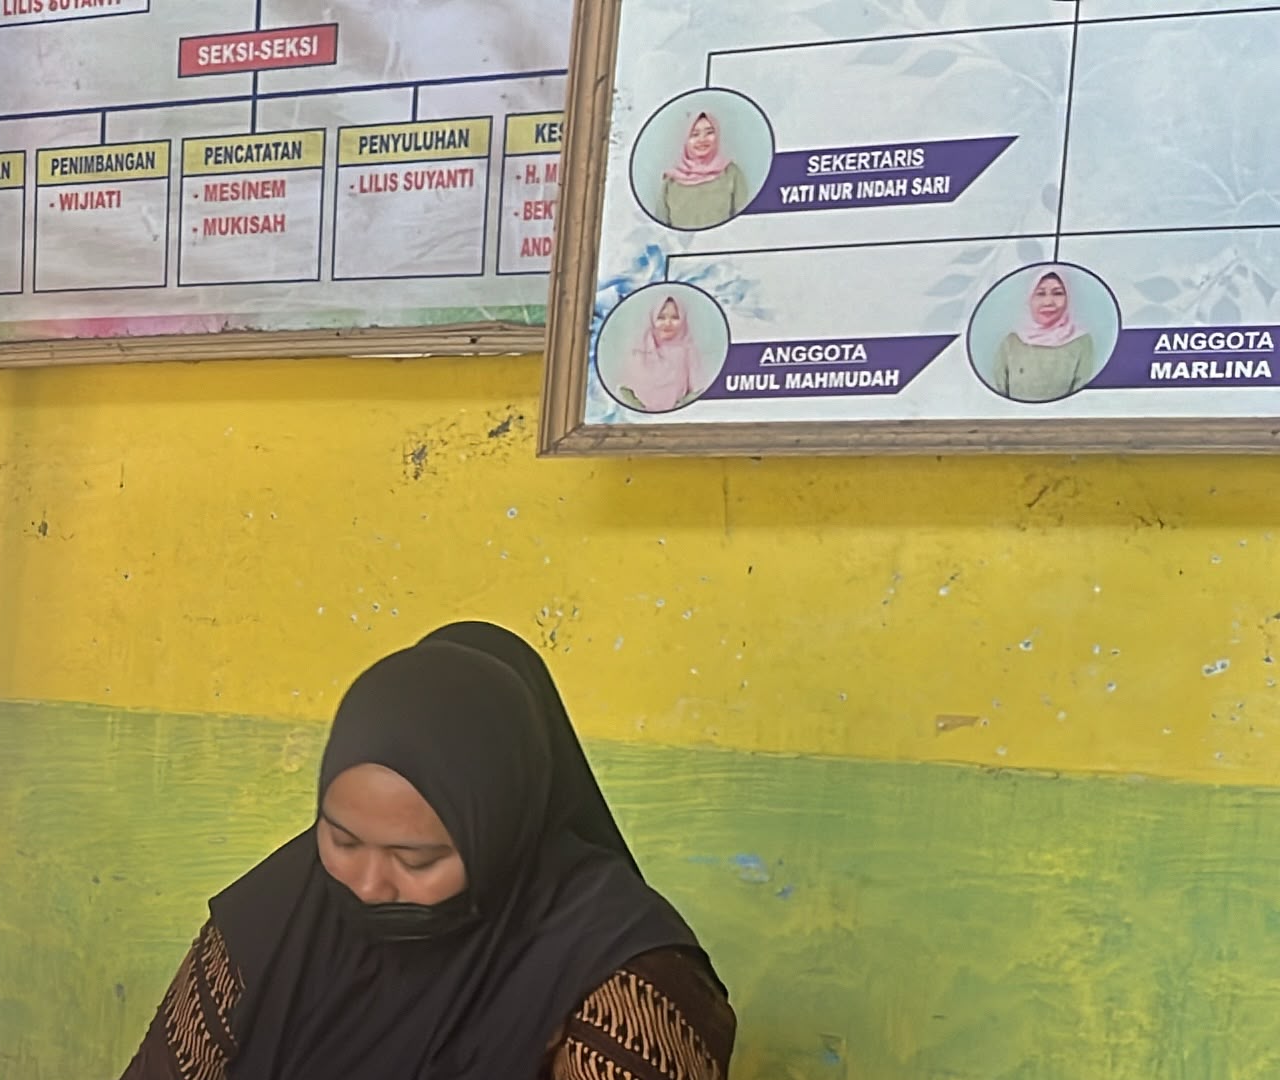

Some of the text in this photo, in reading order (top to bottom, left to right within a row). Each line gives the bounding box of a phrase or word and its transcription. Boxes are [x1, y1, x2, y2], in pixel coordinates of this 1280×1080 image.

[197, 34, 318, 66] SEKSI-SEKSI
[204, 140, 303, 165] PENCATATAN
[358, 128, 470, 155] PENYULUHAN
[51, 151, 156, 176] PENIMBANGAN
[807, 149, 925, 174] SEKERTARIS
[204, 179, 286, 202] MESINEM
[359, 168, 474, 194] LILIS SUYANTI
[780, 176, 951, 204] YATI NUR INDAH SARI
[59, 190, 121, 211] WIJIATI
[523, 200, 557, 221] BEK
[203, 214, 286, 236] MUKISAH
[1153, 331, 1275, 352] ANGGOTA
[759, 344, 868, 365] ANGGOTA
[726, 370, 900, 392] UMUL MAHMUDAH
[1150, 360, 1272, 380] MARLINA
